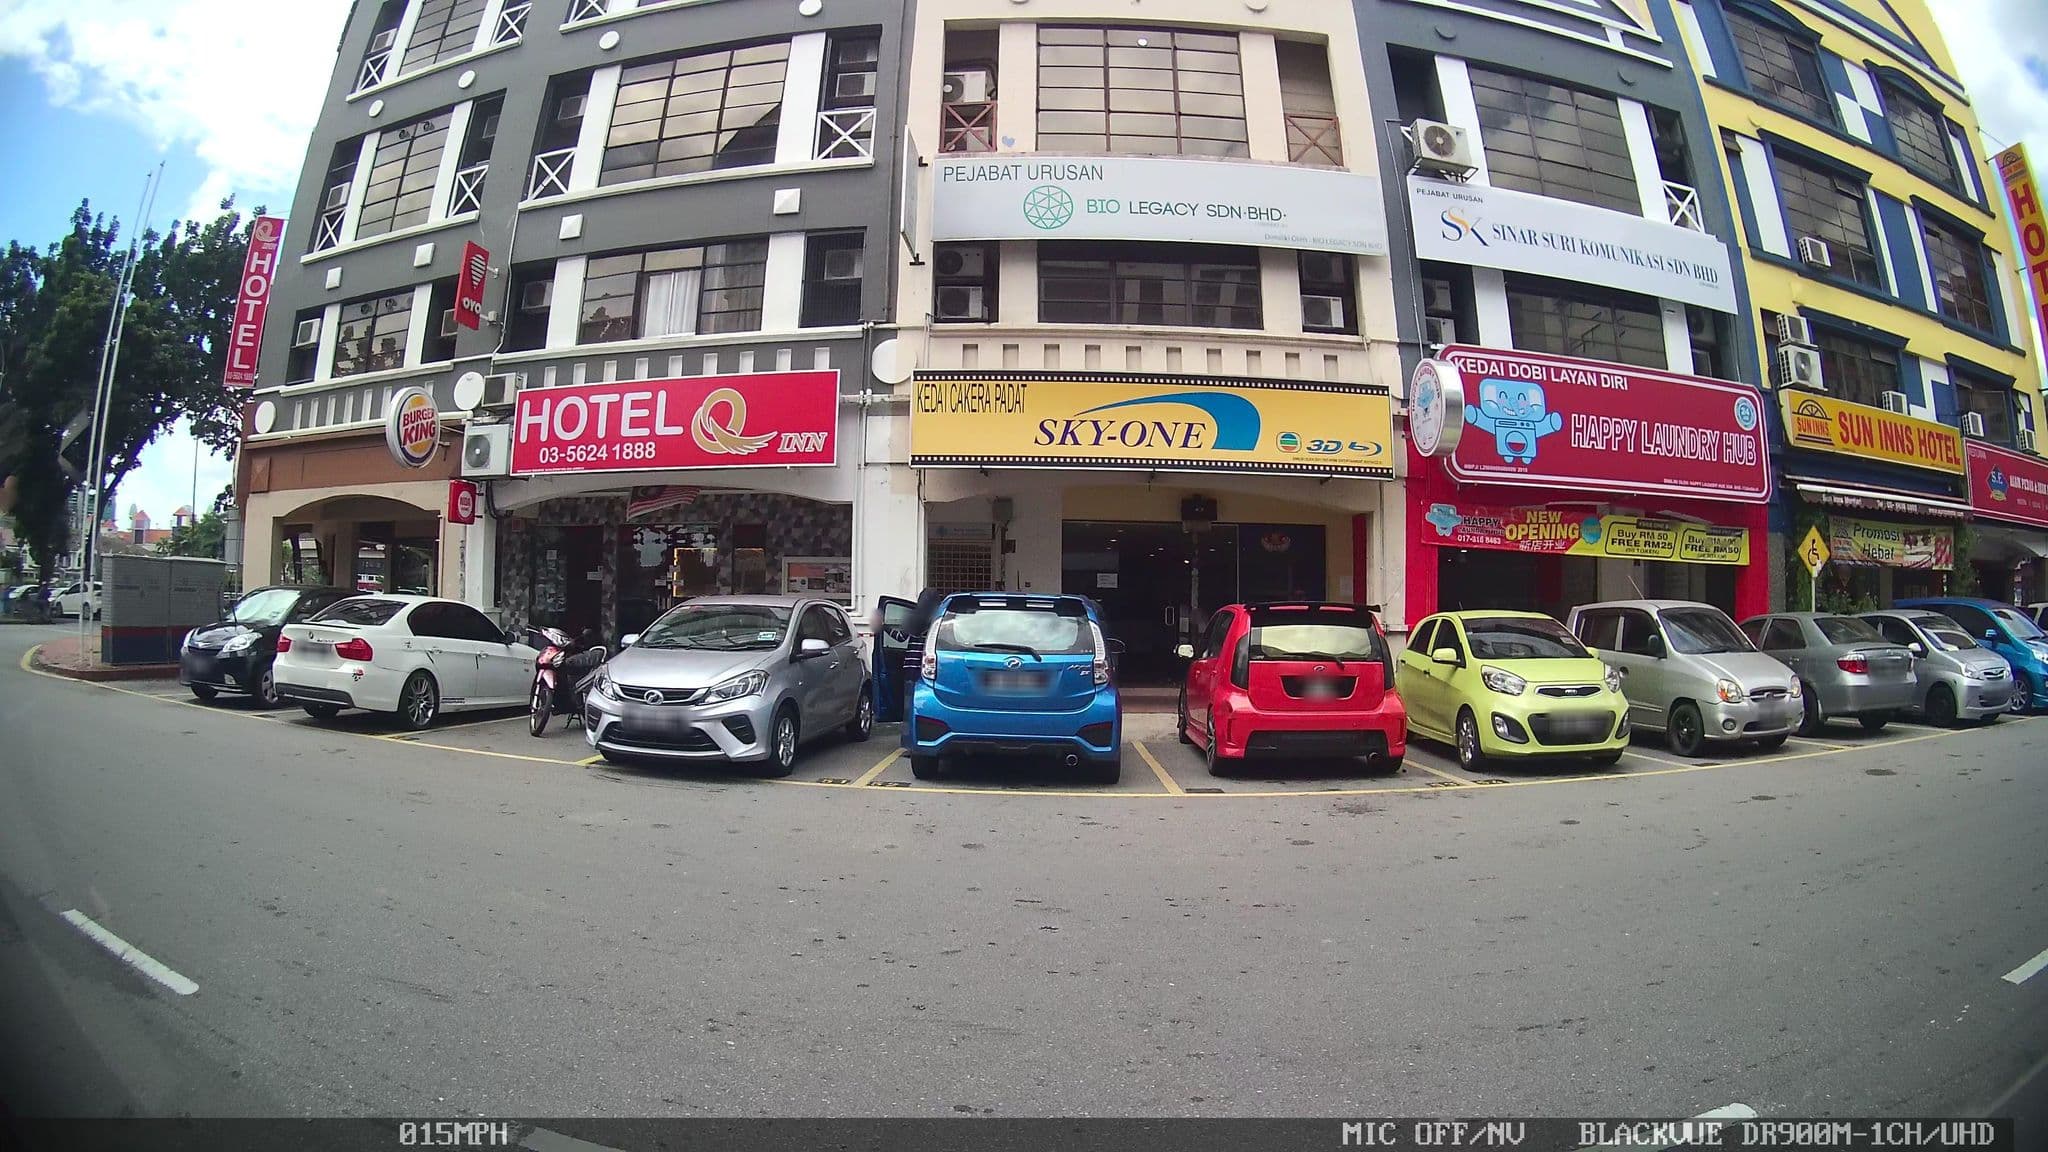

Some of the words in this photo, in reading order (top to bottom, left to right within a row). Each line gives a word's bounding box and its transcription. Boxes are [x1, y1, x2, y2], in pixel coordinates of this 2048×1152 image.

[942, 165, 1021, 183] PEJABAT
[1027, 164, 1104, 182] URUSAN
[1416, 187, 1449, 198] PEJABAT
[1087, 199, 1121, 216] BIO
[1129, 200, 1200, 219] LEGACY
[1492, 223, 1538, 246] SINAR
[1542, 231, 1577, 254] SURI
[1579, 239, 1664, 271] KOMUNIKASI
[1666, 259, 1692, 276] SDN
[1692, 264, 1719, 284] BHD
[232, 251, 272, 370] HOTEL
[463, 296, 482, 315] OYO
[1452, 358, 1504, 378] KEDAI
[1509, 366, 1545, 380] DOBI
[1550, 370, 1596, 387] LAYAN
[1601, 376, 1628, 390] DIRI
[917, 383, 948, 413] KEDAI
[950, 383, 992, 414] CAKERA
[994, 383, 1028, 414] PADAT
[402, 408, 435, 427] BURGER
[520, 389, 684, 443] HOTEL
[777, 432, 828, 453] INN
[402, 423, 436, 447] KING
[1034, 418, 1207, 450] SKY-ONE
[1571, 413, 1638, 453] HAPPY
[1641, 421, 1721, 462] LAUNDRY
[1722, 432, 1757, 466] HUB
[1838, 411, 1874, 448] SUN
[1877, 419, 1915, 456] INNS
[1917, 427, 1961, 466] HOTEL
[540, 445, 608, 465] 03-5624
[612, 441, 657, 461] 1888
[1307, 439, 1344, 456] 3D
[1461, 516, 1499, 526] HAPPY
[1526, 511, 1563, 523] NEW
[1505, 523, 1580, 540] OPENING
[1617, 529, 1637, 542] Buy
[1639, 530, 1656, 541] RM
[1658, 533, 1669, 543] 50
[1688, 535, 1704, 546] Buy
[1853, 523, 1901, 541] Promosi
[1519, 540, 1566, 551] 新店开业
[1611, 538, 1640, 548] FREE
[1644, 540, 1673, 550] RM25
[1685, 543, 1711, 554] FREE
[1713, 546, 1739, 555] RM50
[1862, 543, 1895, 560] Hebat
